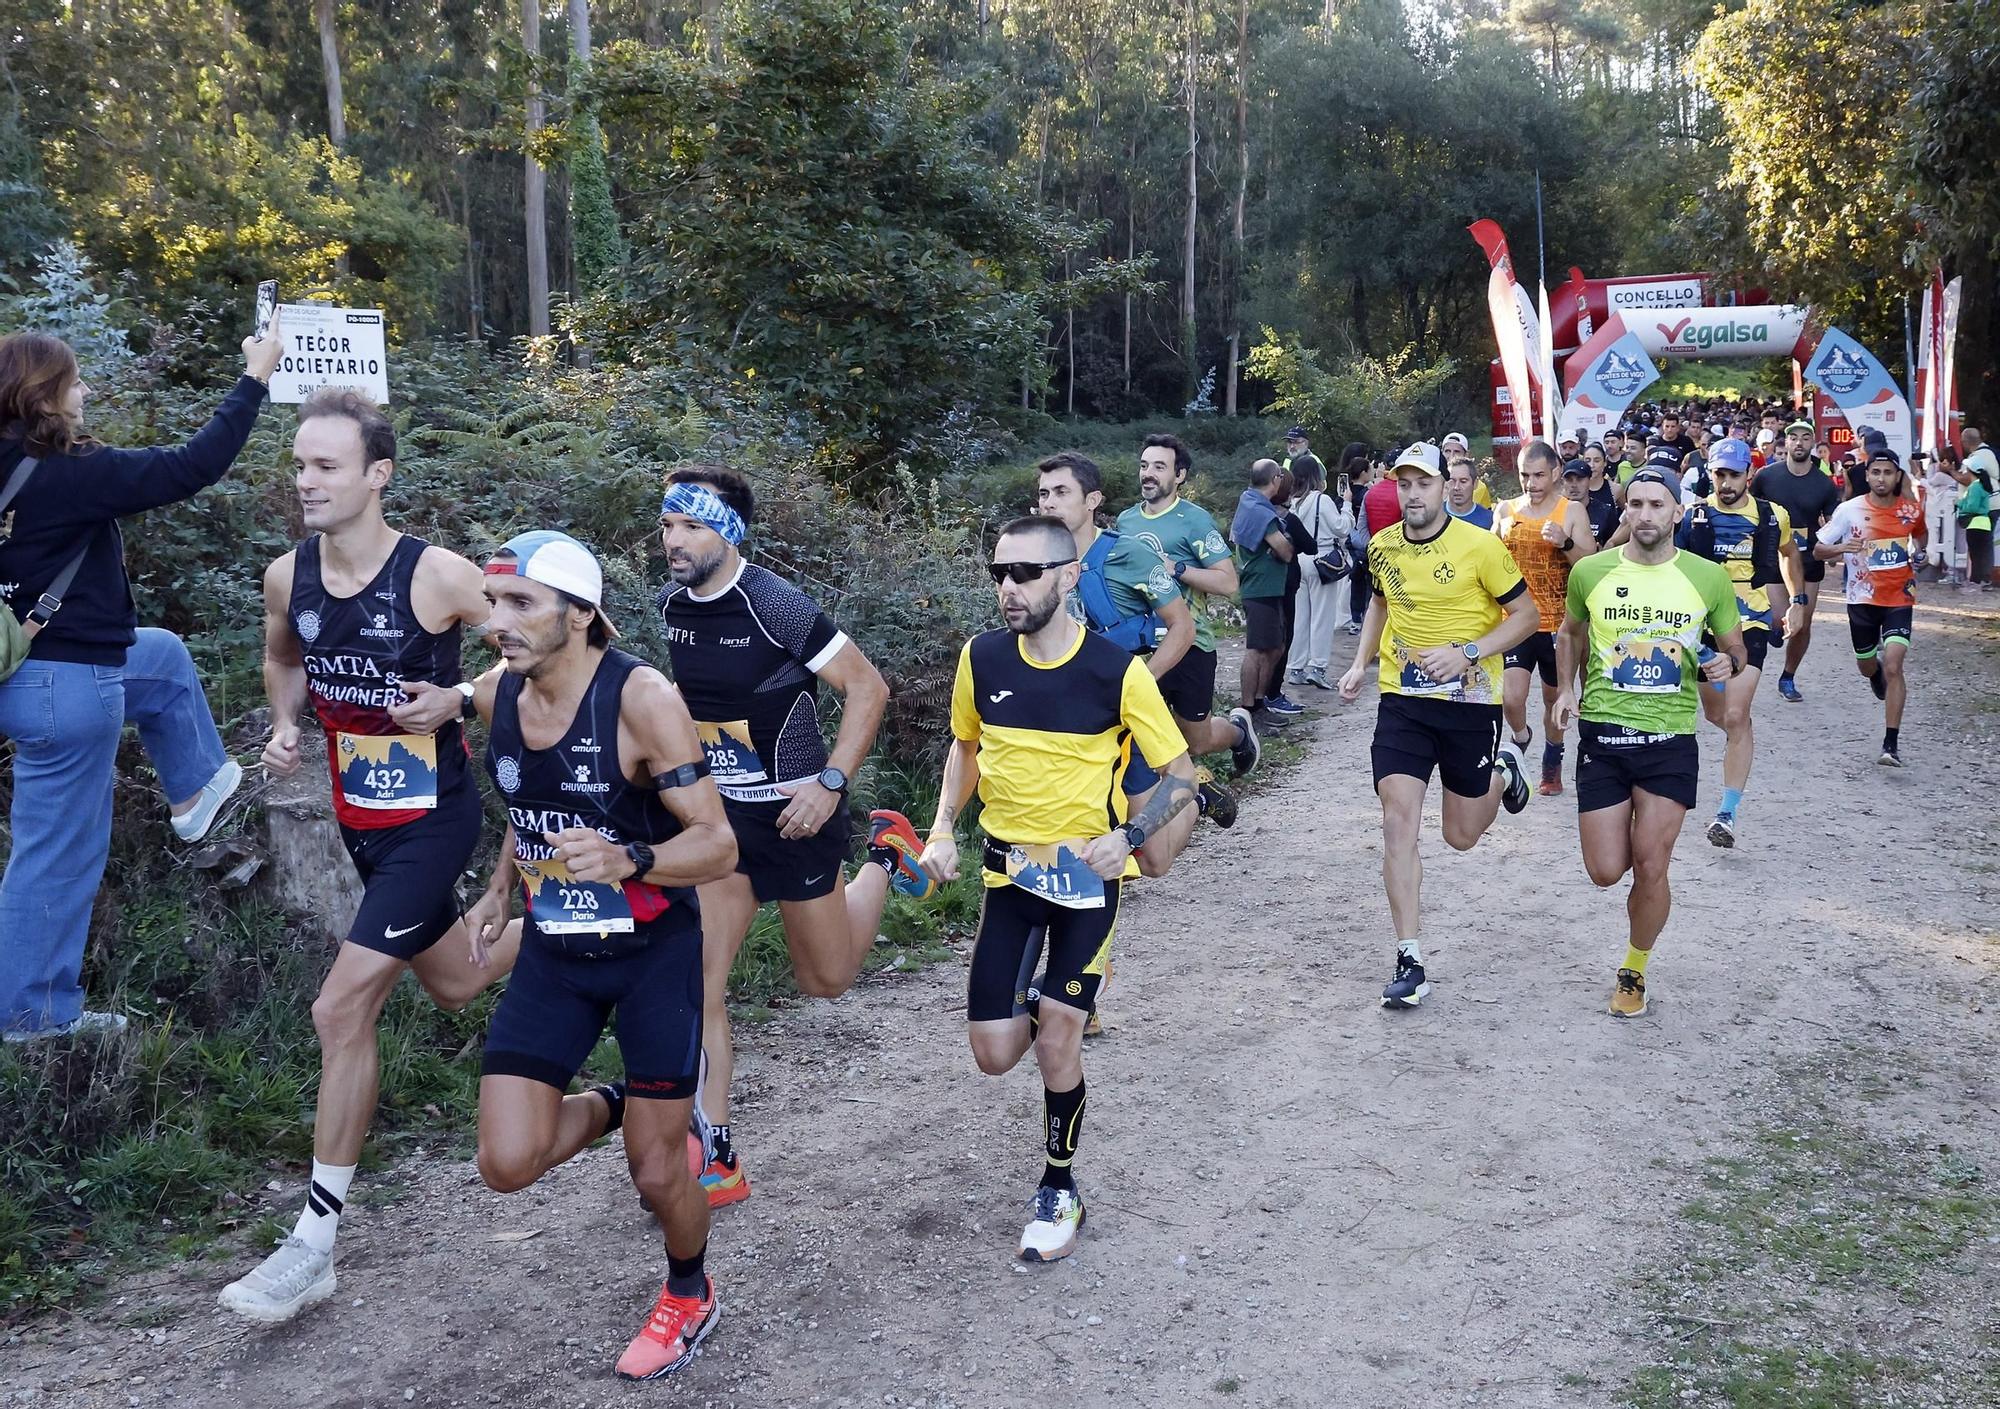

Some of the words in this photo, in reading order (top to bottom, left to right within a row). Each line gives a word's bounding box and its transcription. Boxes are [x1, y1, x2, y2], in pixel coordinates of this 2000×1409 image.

[1615, 288, 1694, 303] CONCELLO
[1657, 317, 1768, 349] Vegalsa
[295, 335, 351, 353] TECOR
[1596, 372, 1620, 380] MONTES
[1880, 551, 1898, 561] 419
[1604, 603, 1640, 620] máis
[1642, 606, 1653, 624] que
[1655, 609, 1691, 629] auga
[360, 628, 404, 638] CHUVONERS
[719, 636, 751, 645] land
[1632, 664, 1662, 679] 280
[384, 671, 404, 685] &
[309, 678, 409, 707] CHUVONERS
[1597, 736, 1646, 745] SPHERE
[571, 745, 602, 753] amura
[707, 749, 738, 767] 285
[363, 769, 407, 789] 432
[561, 782, 610, 793] CHUVONERS
[742, 788, 777, 799] EUROPA
[375, 790, 395, 799] Adri
[1035, 873, 1072, 892] 311
[559, 888, 599, 910] 228
[1054, 891, 1081, 900] Querol
[572, 910, 595, 920] Dario
